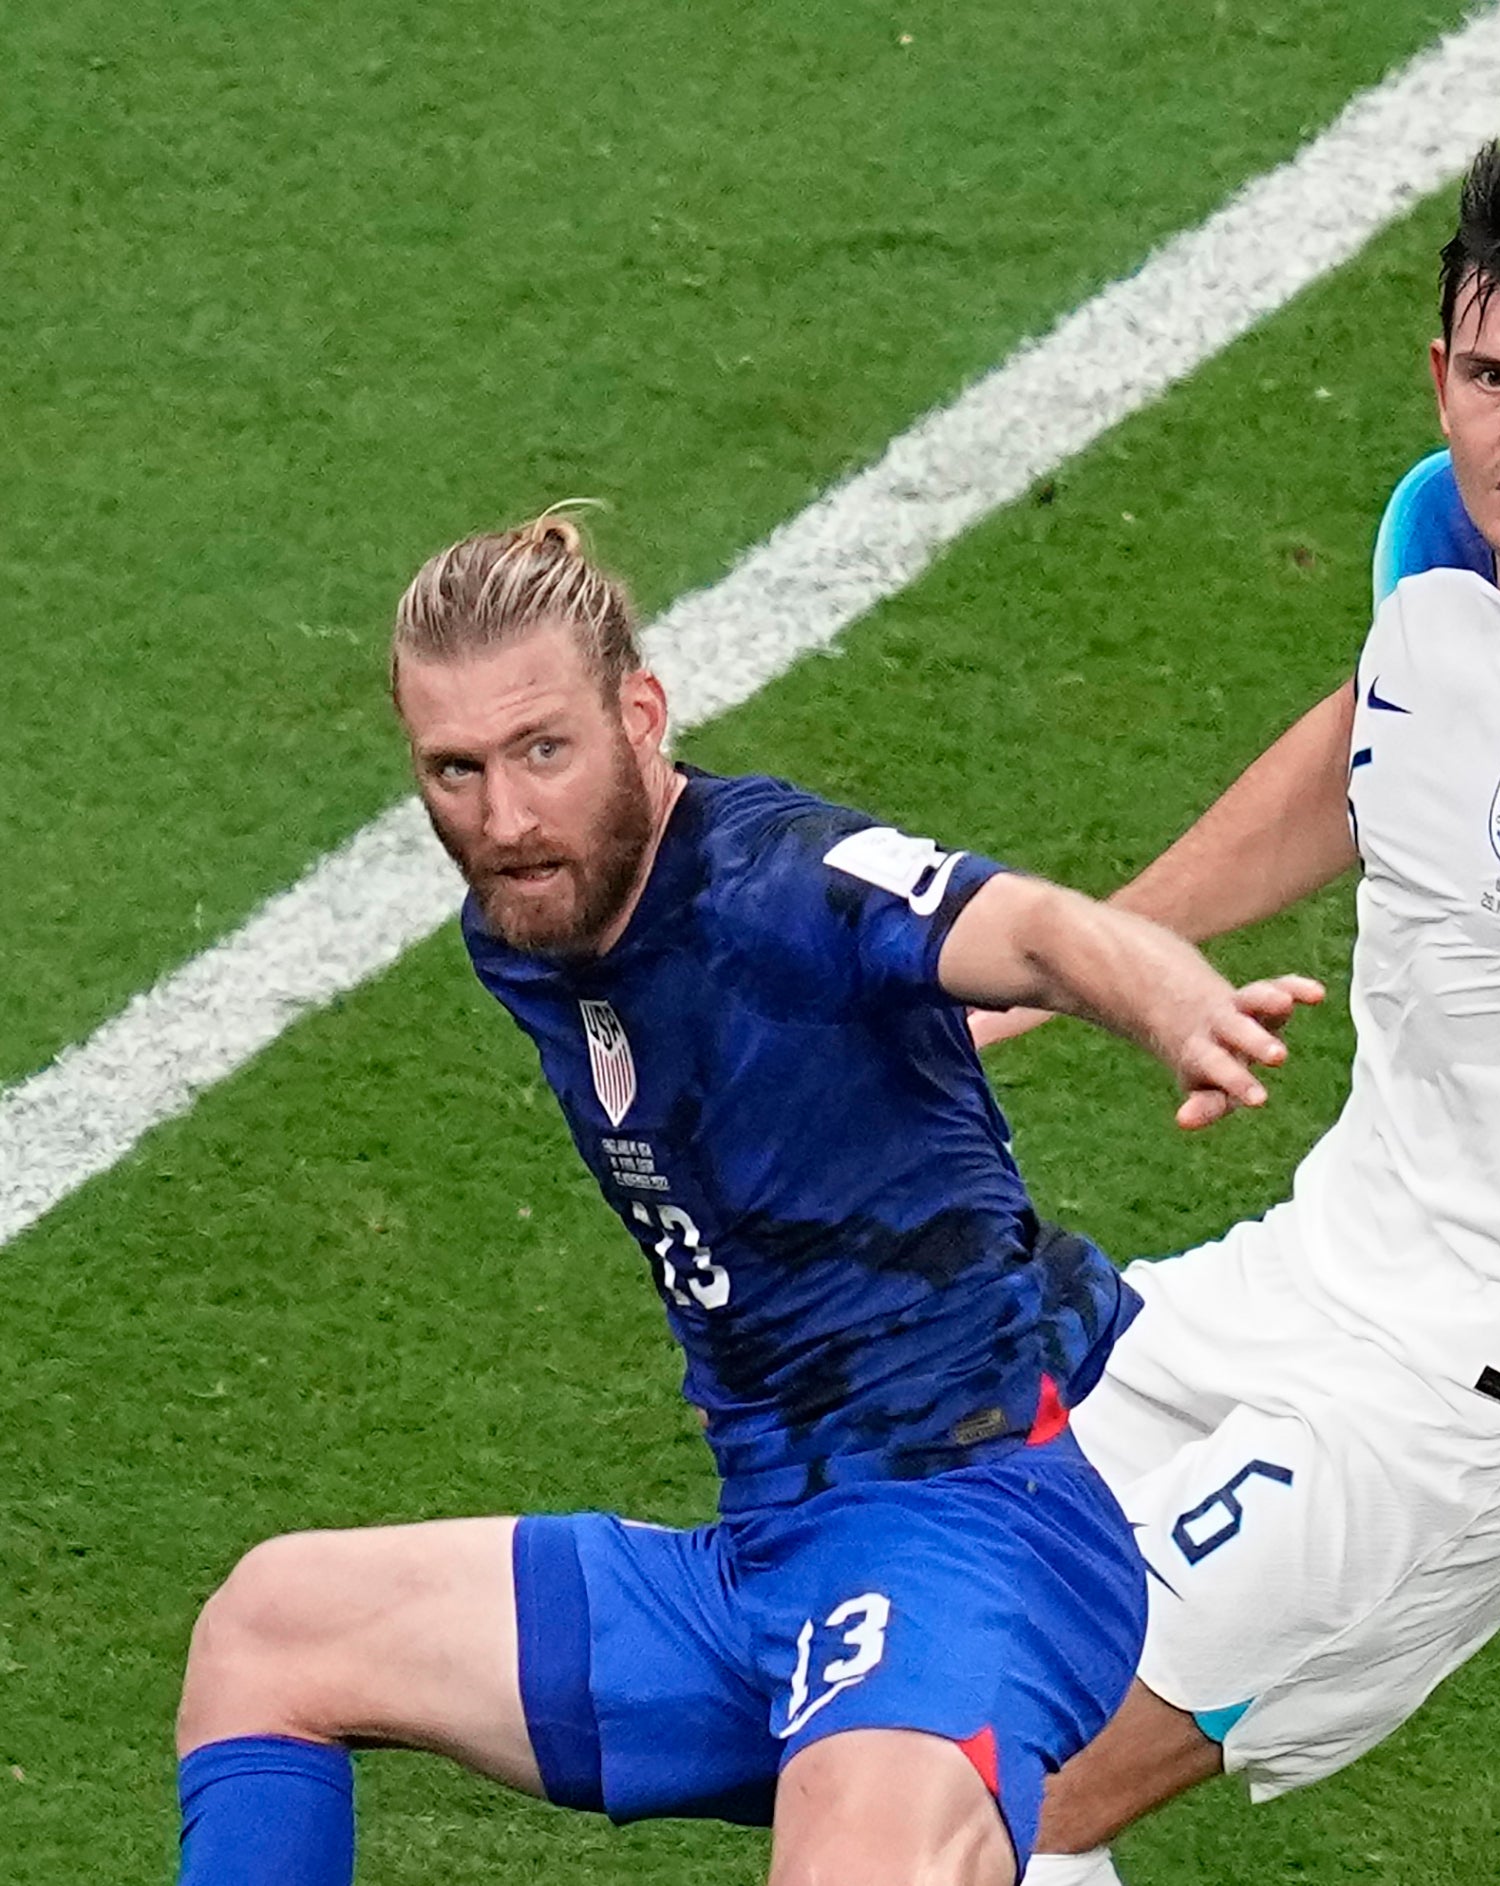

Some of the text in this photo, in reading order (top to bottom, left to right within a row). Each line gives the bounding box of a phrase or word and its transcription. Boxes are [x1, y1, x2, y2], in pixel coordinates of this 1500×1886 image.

[583, 1003, 622, 1052] USA
[631, 1200, 731, 1310] 13
[1171, 1459, 1294, 1566] 6
[787, 1592, 892, 1721] 13
